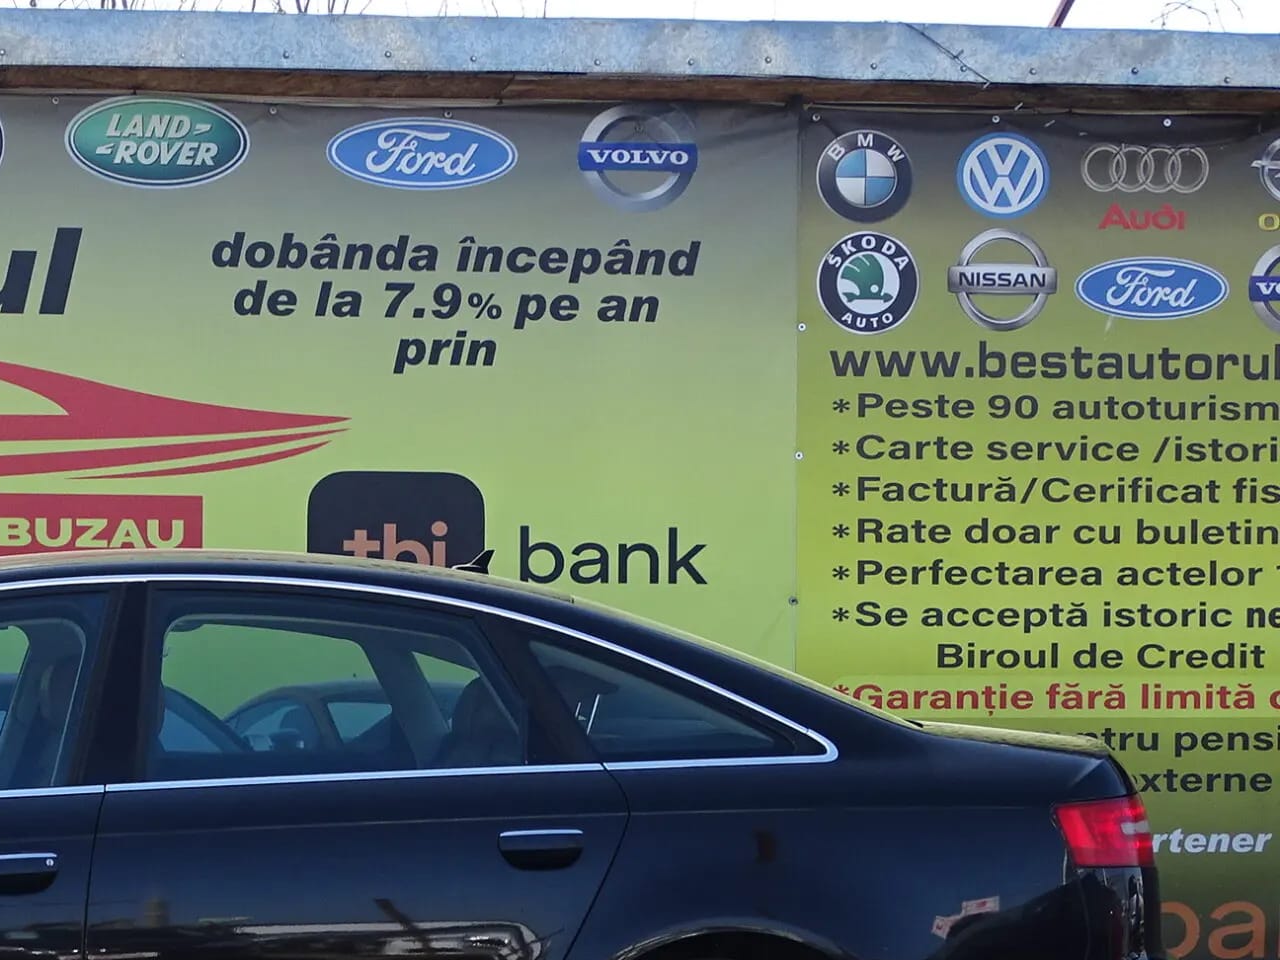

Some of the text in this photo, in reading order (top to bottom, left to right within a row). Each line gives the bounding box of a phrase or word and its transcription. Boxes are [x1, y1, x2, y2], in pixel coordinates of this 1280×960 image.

[366, 129, 476, 179] Ford
[587, 149, 689, 166] VOLVO
[827, 134, 905, 162] BMW
[1099, 203, 1187, 230] Audi
[211, 232, 701, 283] dobânda începând
[958, 271, 1047, 288] NISSAN
[1105, 264, 1195, 308] Ford
[233, 280, 661, 329] de la 7.9% pe an
[841, 312, 893, 328] AUTO
[393, 331, 498, 374] prin
[988, 395, 1039, 420] 90
[987, 436, 1140, 463] service
[964, 517, 1061, 545] doar
[1073, 526, 1121, 545] cu
[520, 525, 708, 585] bank
[1116, 560, 1263, 586] actelor
[921, 602, 1089, 634] acceptă
[1103, 602, 1232, 628] istoric
[937, 643, 1265, 669] Biroul de Credit
[1046, 682, 1126, 710] fără
[1140, 682, 1256, 710] limită
